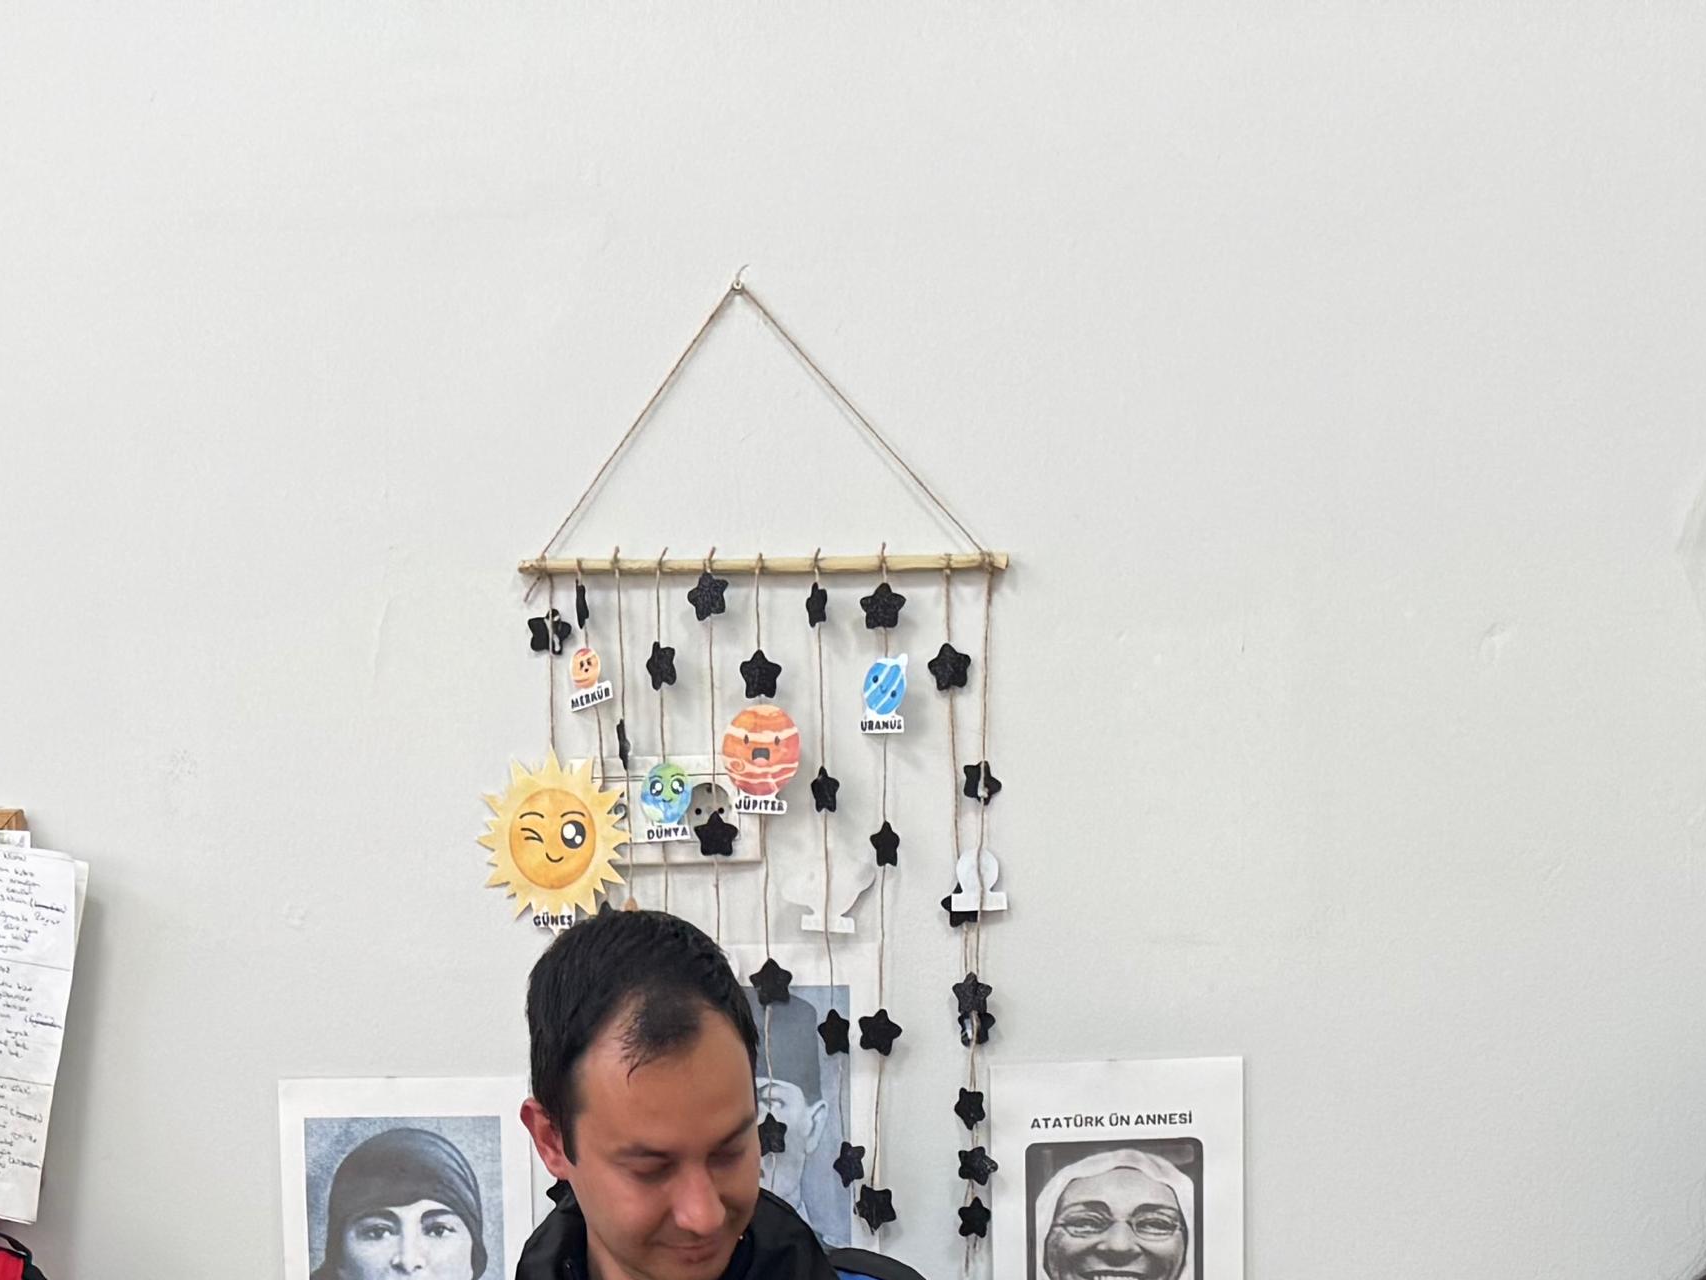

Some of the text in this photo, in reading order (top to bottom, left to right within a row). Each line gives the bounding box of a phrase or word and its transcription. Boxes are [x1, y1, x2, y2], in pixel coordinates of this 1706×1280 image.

[570, 684, 611, 711] MERKÜR
[646, 824, 690, 841] DÜNYA
[533, 912, 573, 928] GÜNEŞ
[1030, 1109, 1193, 1130] ATATÜRK ÜN ANNESİ
